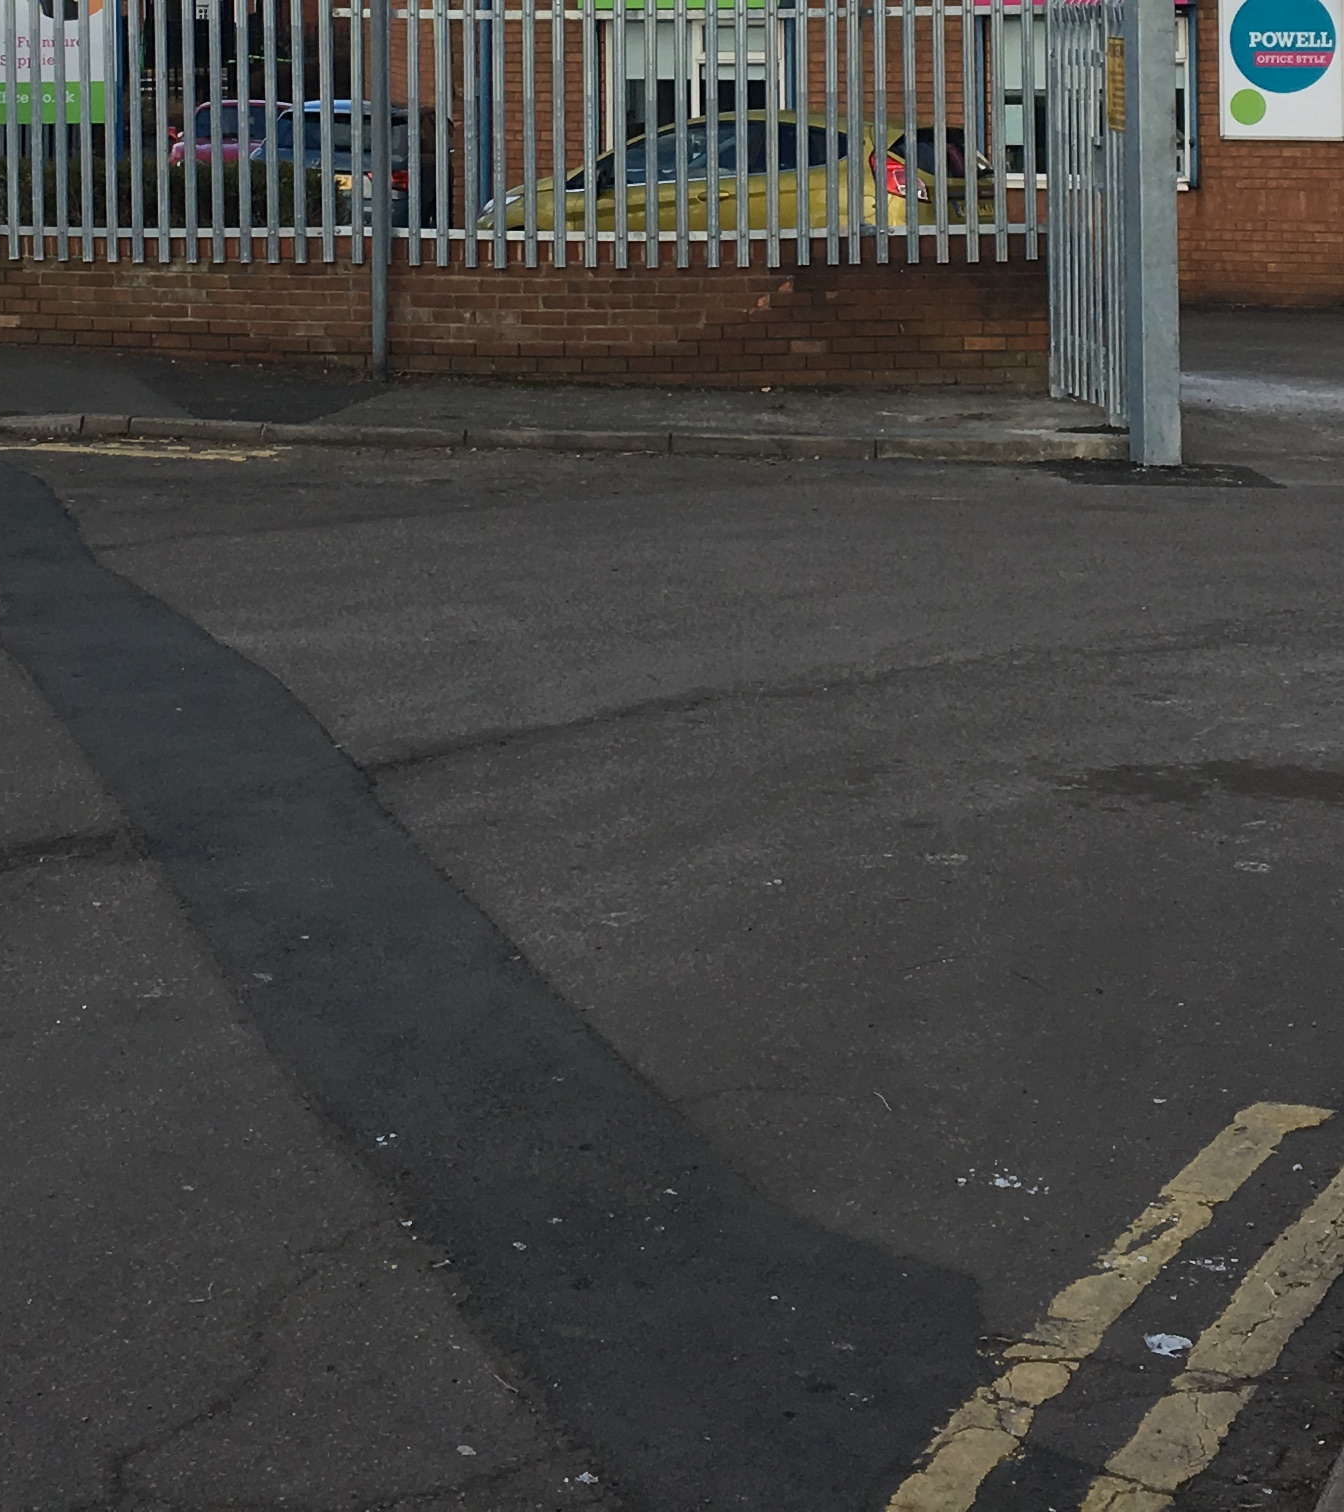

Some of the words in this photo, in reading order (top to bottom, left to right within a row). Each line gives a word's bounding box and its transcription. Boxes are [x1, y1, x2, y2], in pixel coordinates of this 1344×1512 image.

[1248, 31, 1333, 48] POWELL
[1256, 54, 1294, 64] OFFICE
[1296, 54, 1327, 64] STYLE
